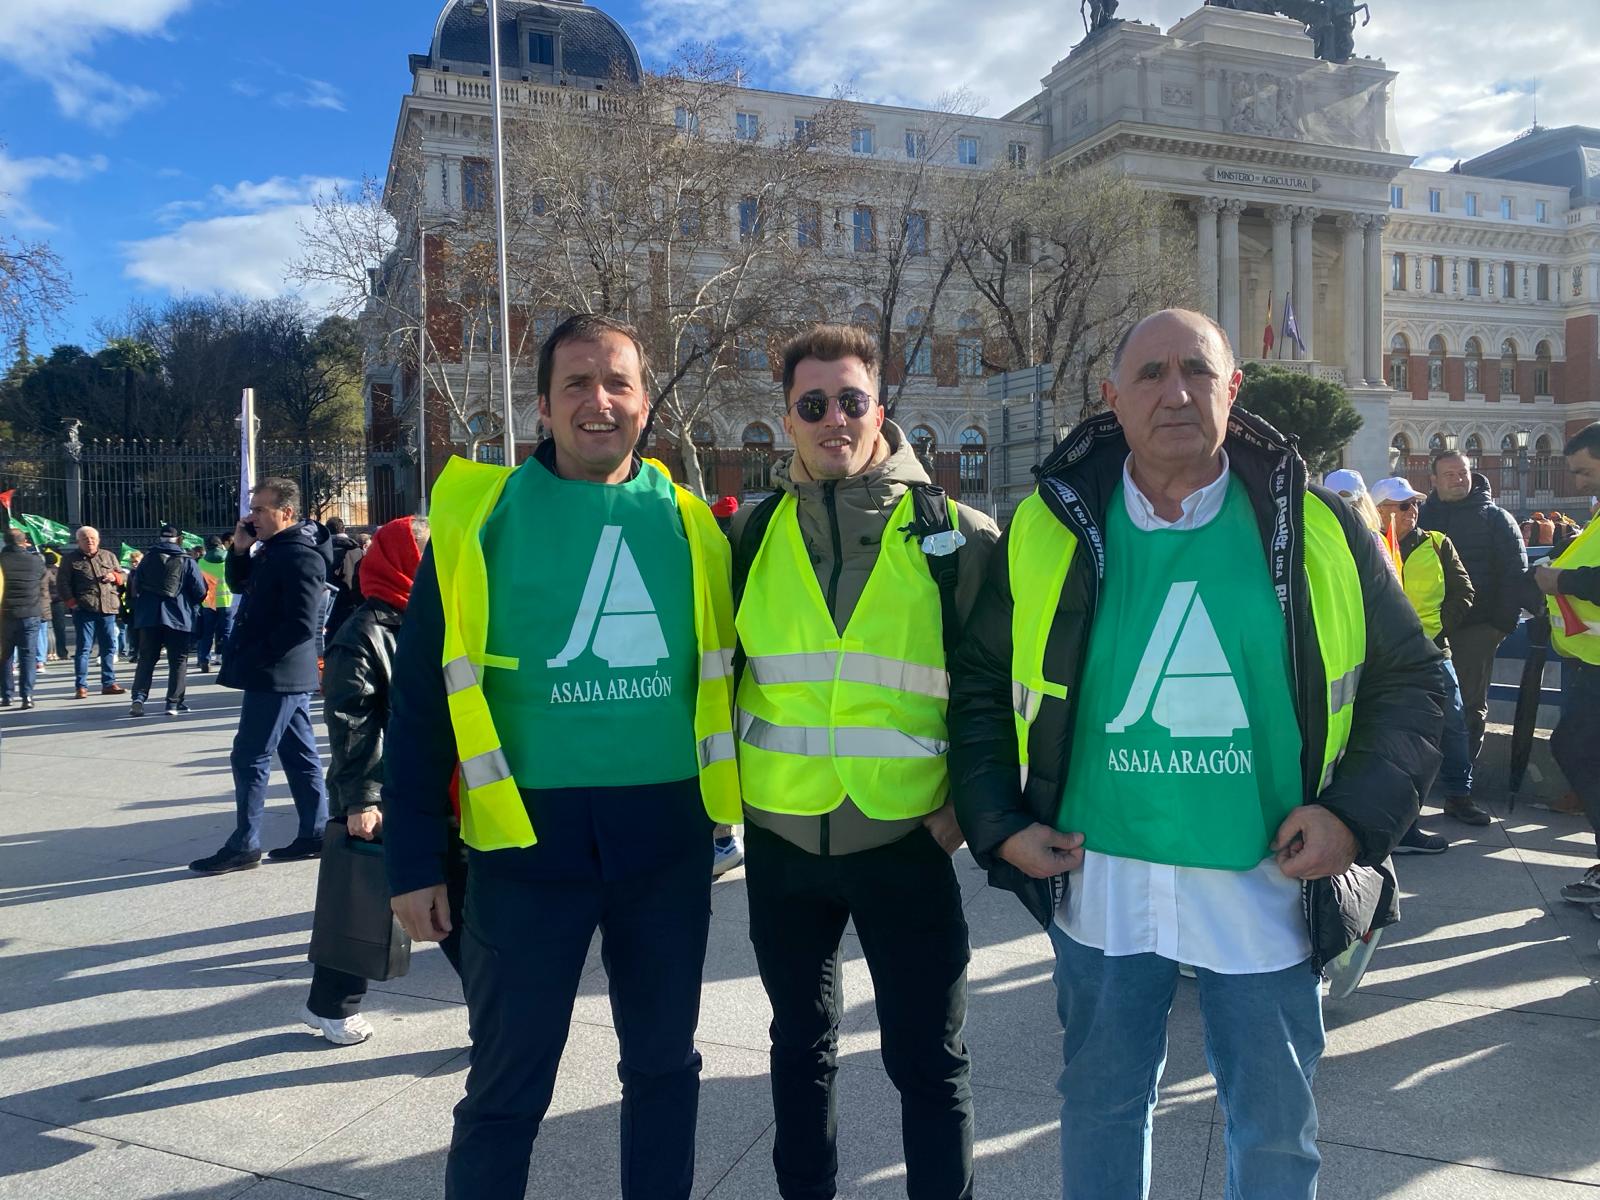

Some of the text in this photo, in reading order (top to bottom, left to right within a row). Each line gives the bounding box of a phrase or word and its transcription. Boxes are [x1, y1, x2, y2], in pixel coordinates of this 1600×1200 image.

[1216, 169, 1255, 181] MINISTERIO
[1261, 175, 1307, 188] AGRICULTURA
[1276, 474, 1285, 493] USA
[1073, 504, 1088, 525] USA
[1276, 555, 1284, 579] USA
[550, 670, 672, 704] ASAJA ARAGÓN
[1108, 743, 1253, 775] ASAJA ARAGÓN
